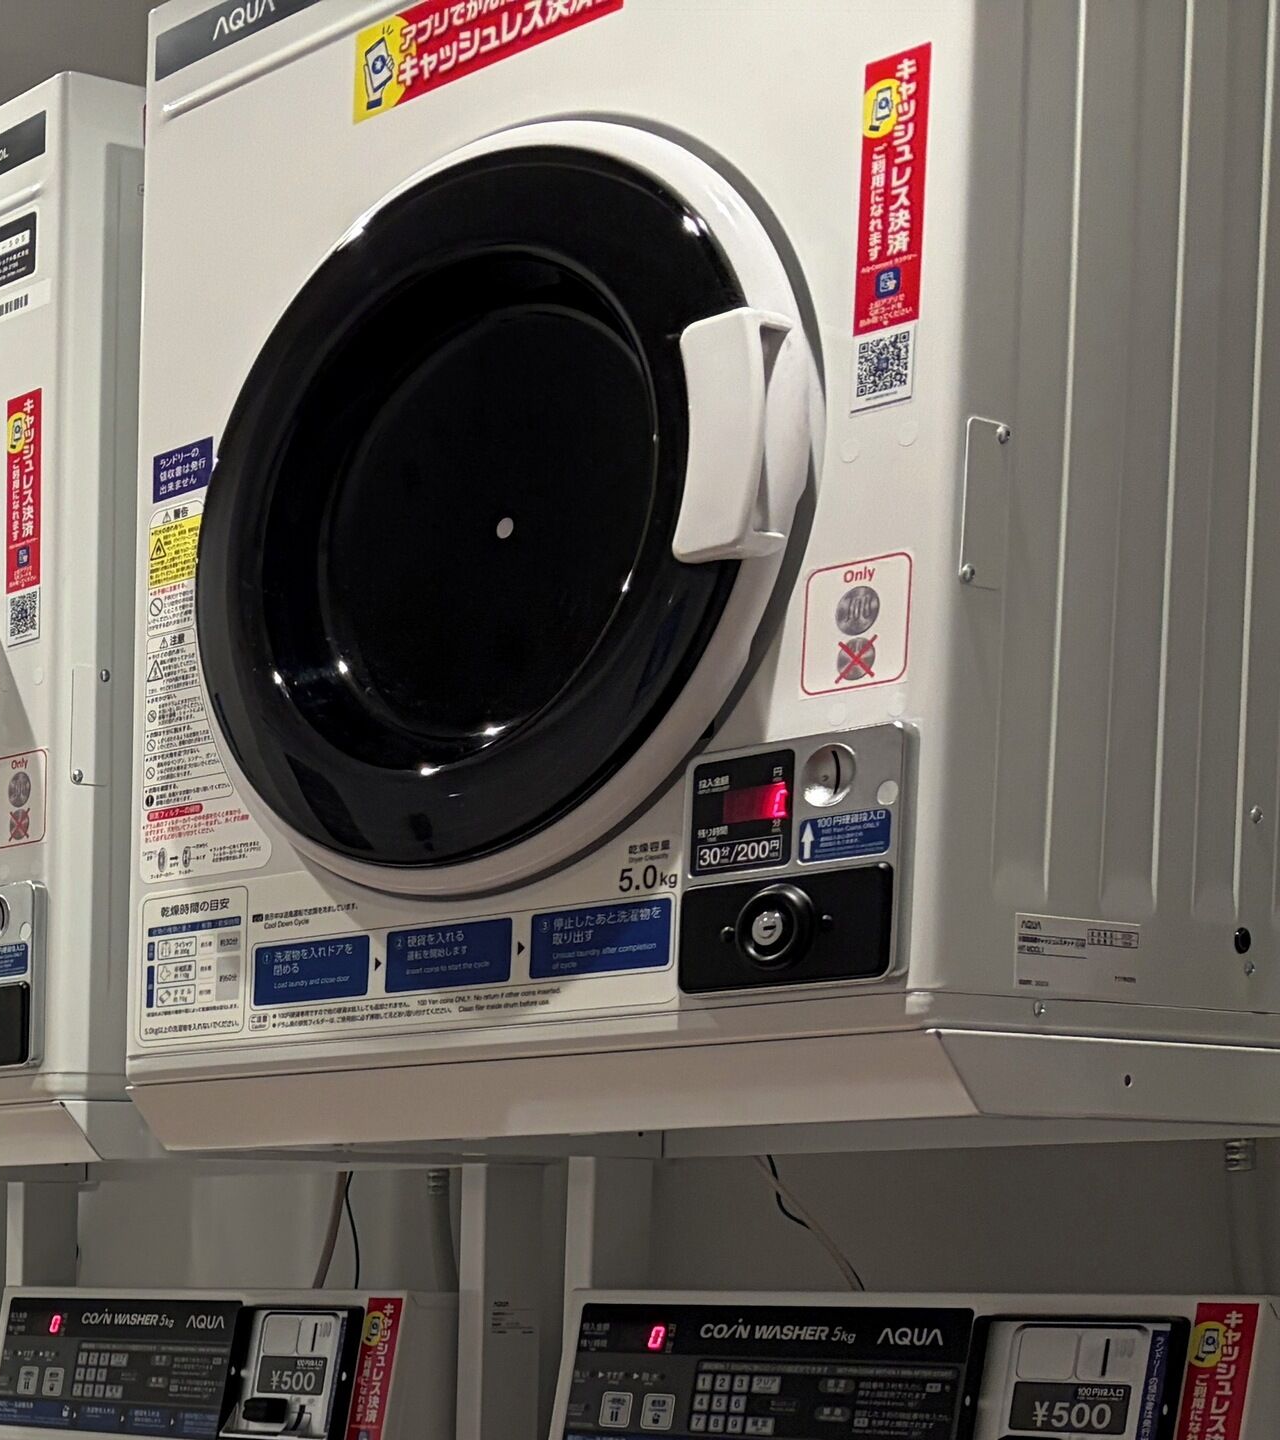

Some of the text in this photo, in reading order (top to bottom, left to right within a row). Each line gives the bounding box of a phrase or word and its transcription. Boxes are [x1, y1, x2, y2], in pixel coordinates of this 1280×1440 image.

[212, 0, 276, 41] AQUA
[887, 58, 918, 255] キャッシュレス決済
[869, 142, 887, 261] ご利用になれます
[21, 397, 35, 537] キャッシュレス決済
[159, 447, 200, 469] ランドリーの
[159, 475, 198, 495] 出来ません
[843, 565, 876, 584] Only
[10, 756, 29, 770] Only
[160, 898, 230, 918] 乾燥時間の目安
[553, 905, 661, 931] 停止したあと洗濯物を
[264, 921, 277, 930] Cool
[294, 918, 310, 928] Cycle
[407, 930, 464, 947] 硬貨を入れる
[552, 930, 593, 946] 取り出す
[273, 943, 353, 962] 洗濯物を入れドアを
[273, 962, 300, 977] 閉める
[49, 1314, 61, 1333] 0
[114, 1313, 158, 1326] WASHER
[159, 1314, 174, 1328] 5kg
[186, 1315, 225, 1330] AQUA
[647, 1325, 666, 1348] 0
[753, 1325, 829, 1341] WASHER
[831, 1326, 857, 1345] 5kg
[876, 1327, 944, 1346] AQUA
[365, 1303, 395, 1424] キャッシュレス決済
[270, 1371, 316, 1391] ¥500
[1032, 1400, 1112, 1430] ¥500
